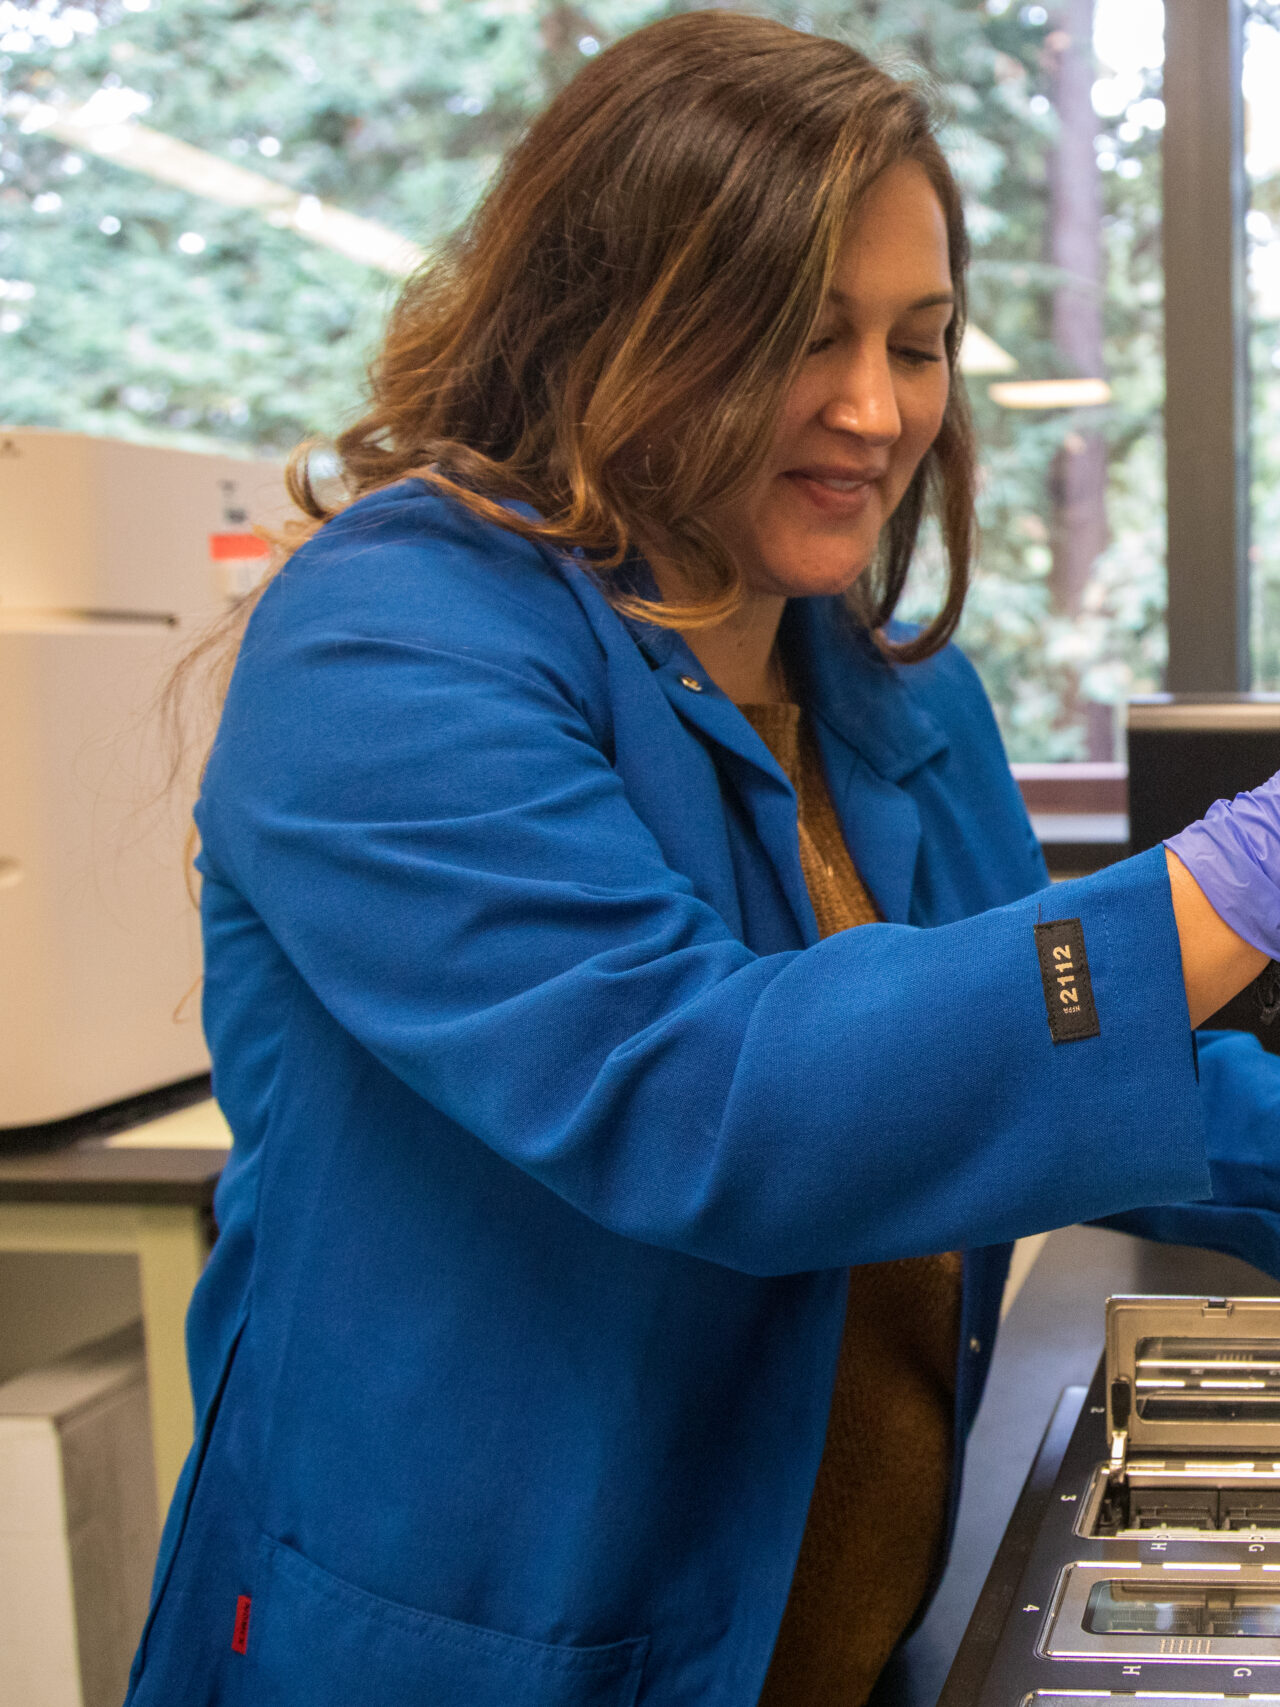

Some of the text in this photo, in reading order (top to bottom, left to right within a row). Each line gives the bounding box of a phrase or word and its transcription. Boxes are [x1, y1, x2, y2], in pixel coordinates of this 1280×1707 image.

[1052, 944, 1079, 1004] 2112
[1061, 1494, 1077, 1502] 3
[1248, 1544, 1265, 1552] G
[1022, 1604, 1040, 1612] 4
[1122, 1665, 1142, 1675] H
[1233, 1667, 1252, 1677] G
